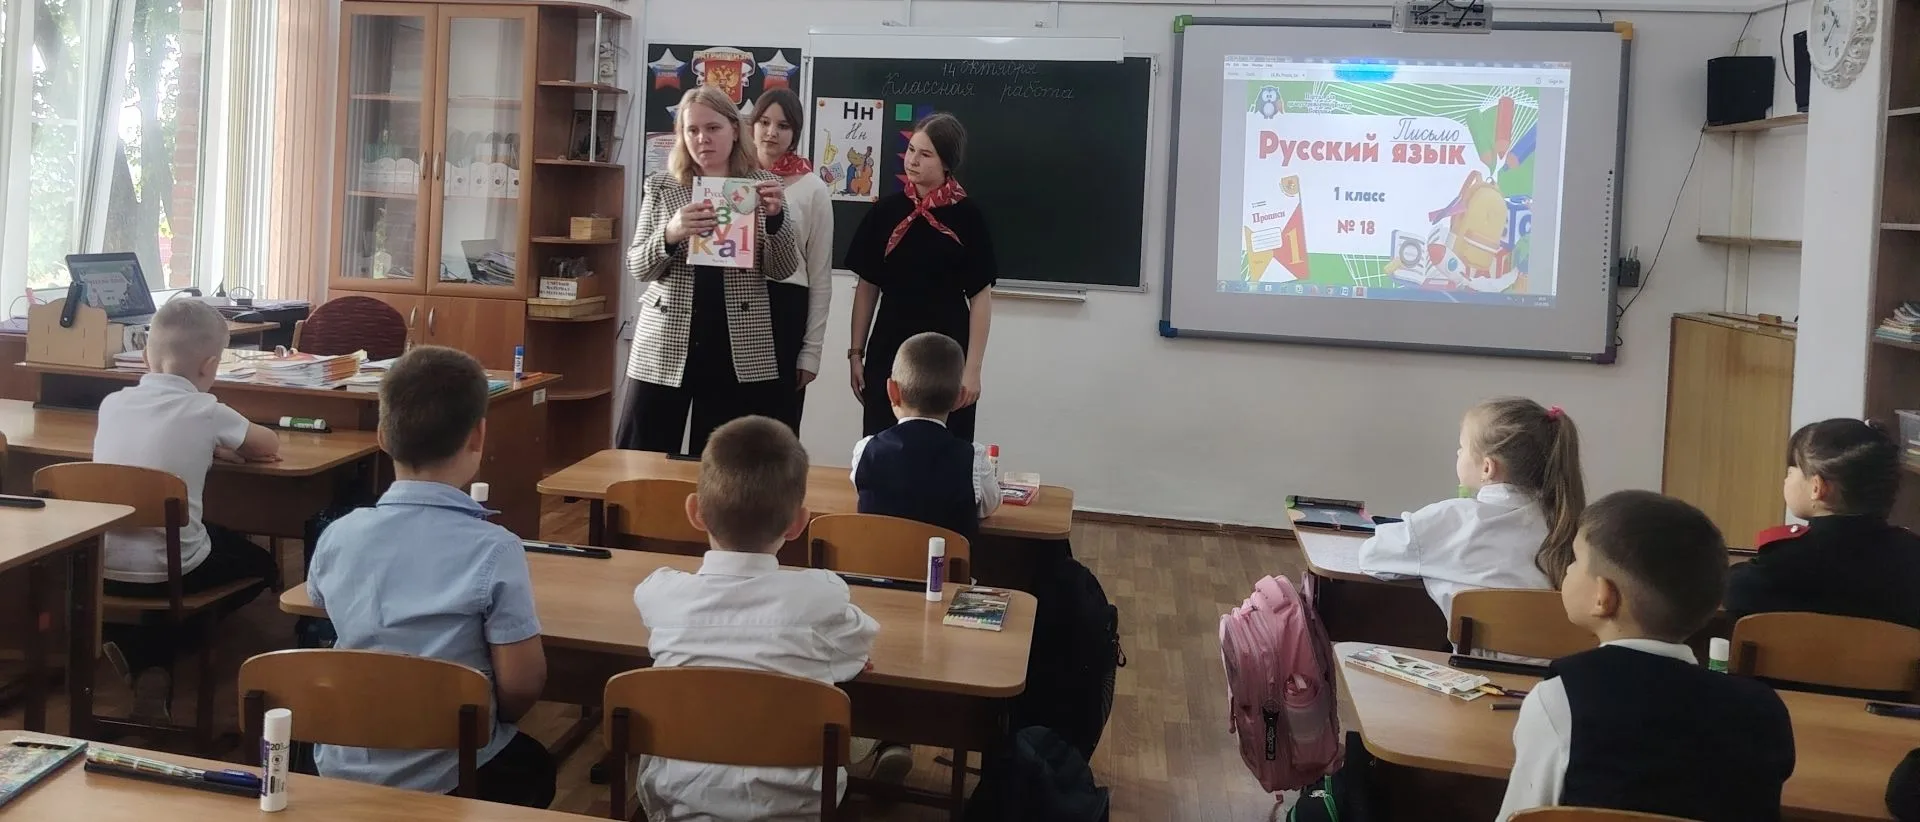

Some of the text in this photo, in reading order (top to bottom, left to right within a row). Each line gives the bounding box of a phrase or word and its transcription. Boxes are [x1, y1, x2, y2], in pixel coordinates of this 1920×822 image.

[943, 63, 955, 77] 14
[882, 72, 1075, 102] Классная работа
[1393, 117, 1460, 142] Письмо
[1259, 130, 1466, 167] Русский язык
[1333, 186, 1386, 203] 1 класс
[1252, 211, 1286, 224] Прописи
[1337, 219, 1376, 235] № 18
